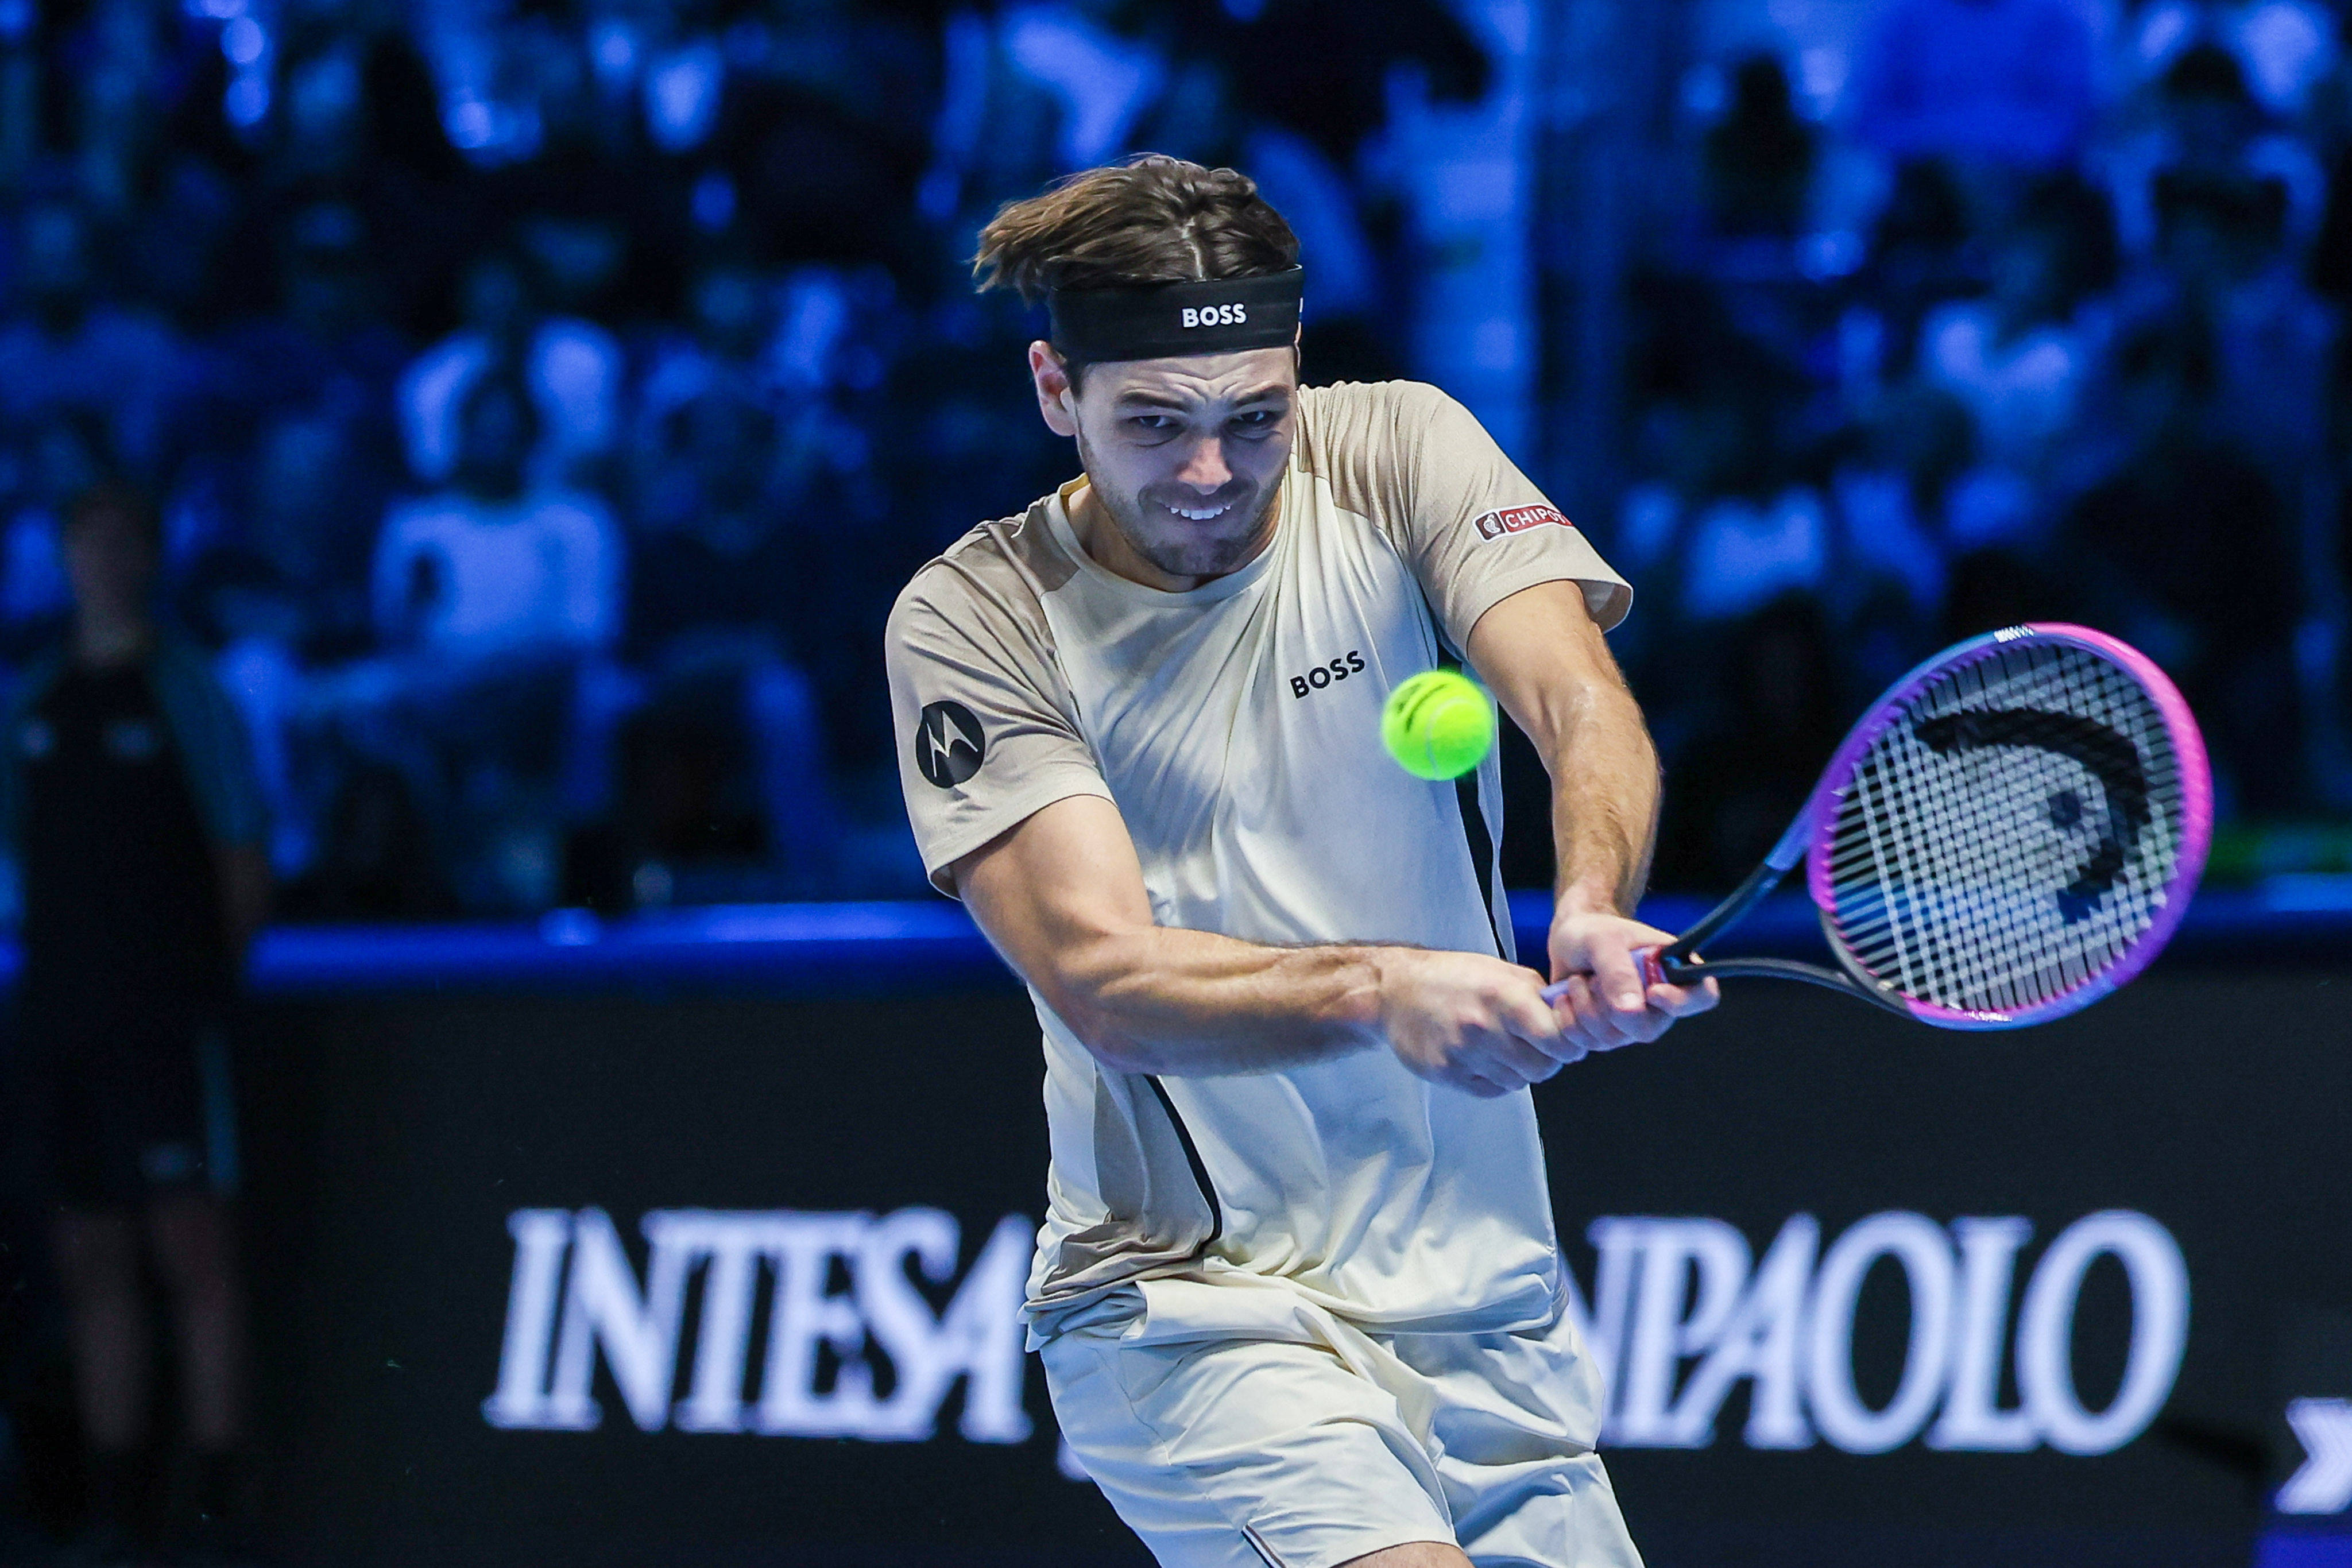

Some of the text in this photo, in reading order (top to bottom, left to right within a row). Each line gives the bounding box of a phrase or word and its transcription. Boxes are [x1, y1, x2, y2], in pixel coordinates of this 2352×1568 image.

[1182, 303, 1247, 328] BOSS
[1290, 650, 1365, 699] BOSS
[481, 1205, 1034, 1443] INTESA
